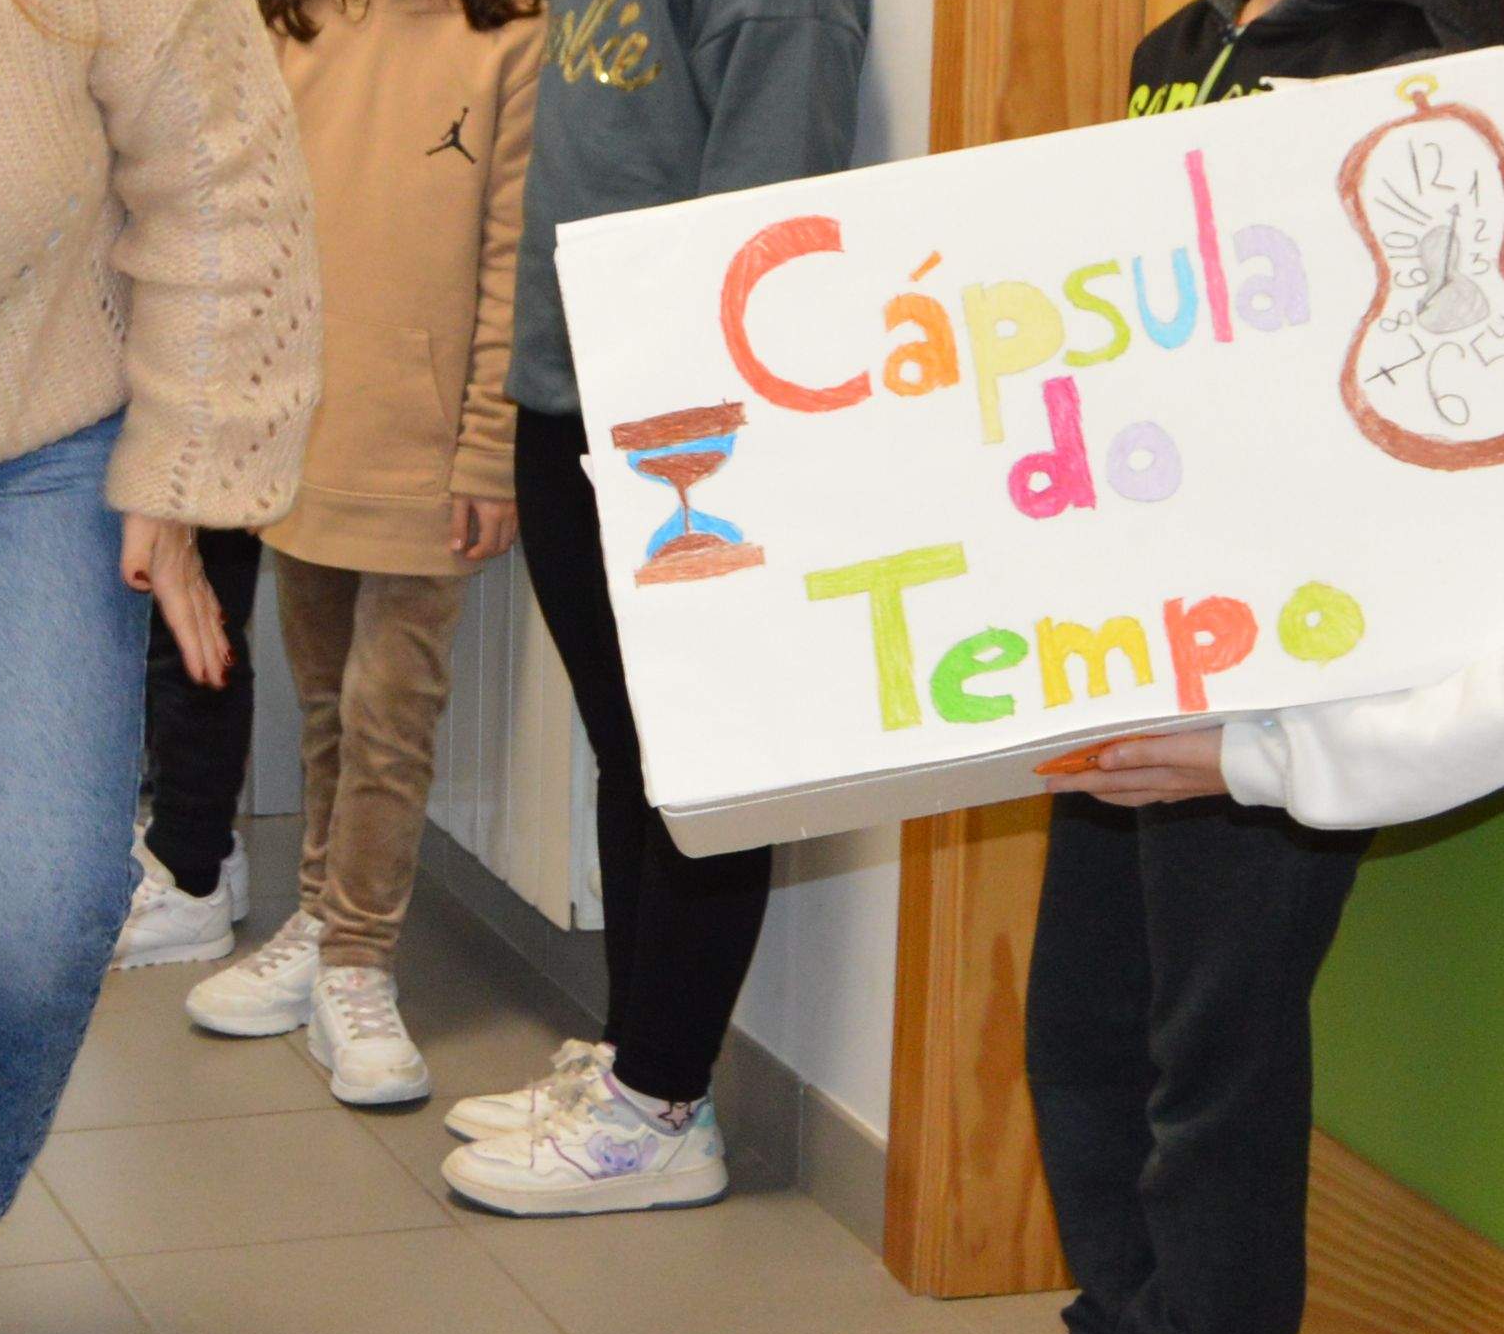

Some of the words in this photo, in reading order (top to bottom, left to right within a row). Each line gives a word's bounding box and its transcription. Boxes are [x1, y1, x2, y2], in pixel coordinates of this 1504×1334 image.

[1408, 138, 1456, 195] 12
[1474, 218, 1491, 243] 2
[720, 150, 1312, 445] Cápsula
[1426, 341, 1471, 426] 6
[1006, 375, 1184, 521] do
[803, 541, 1367, 733] Tempo
